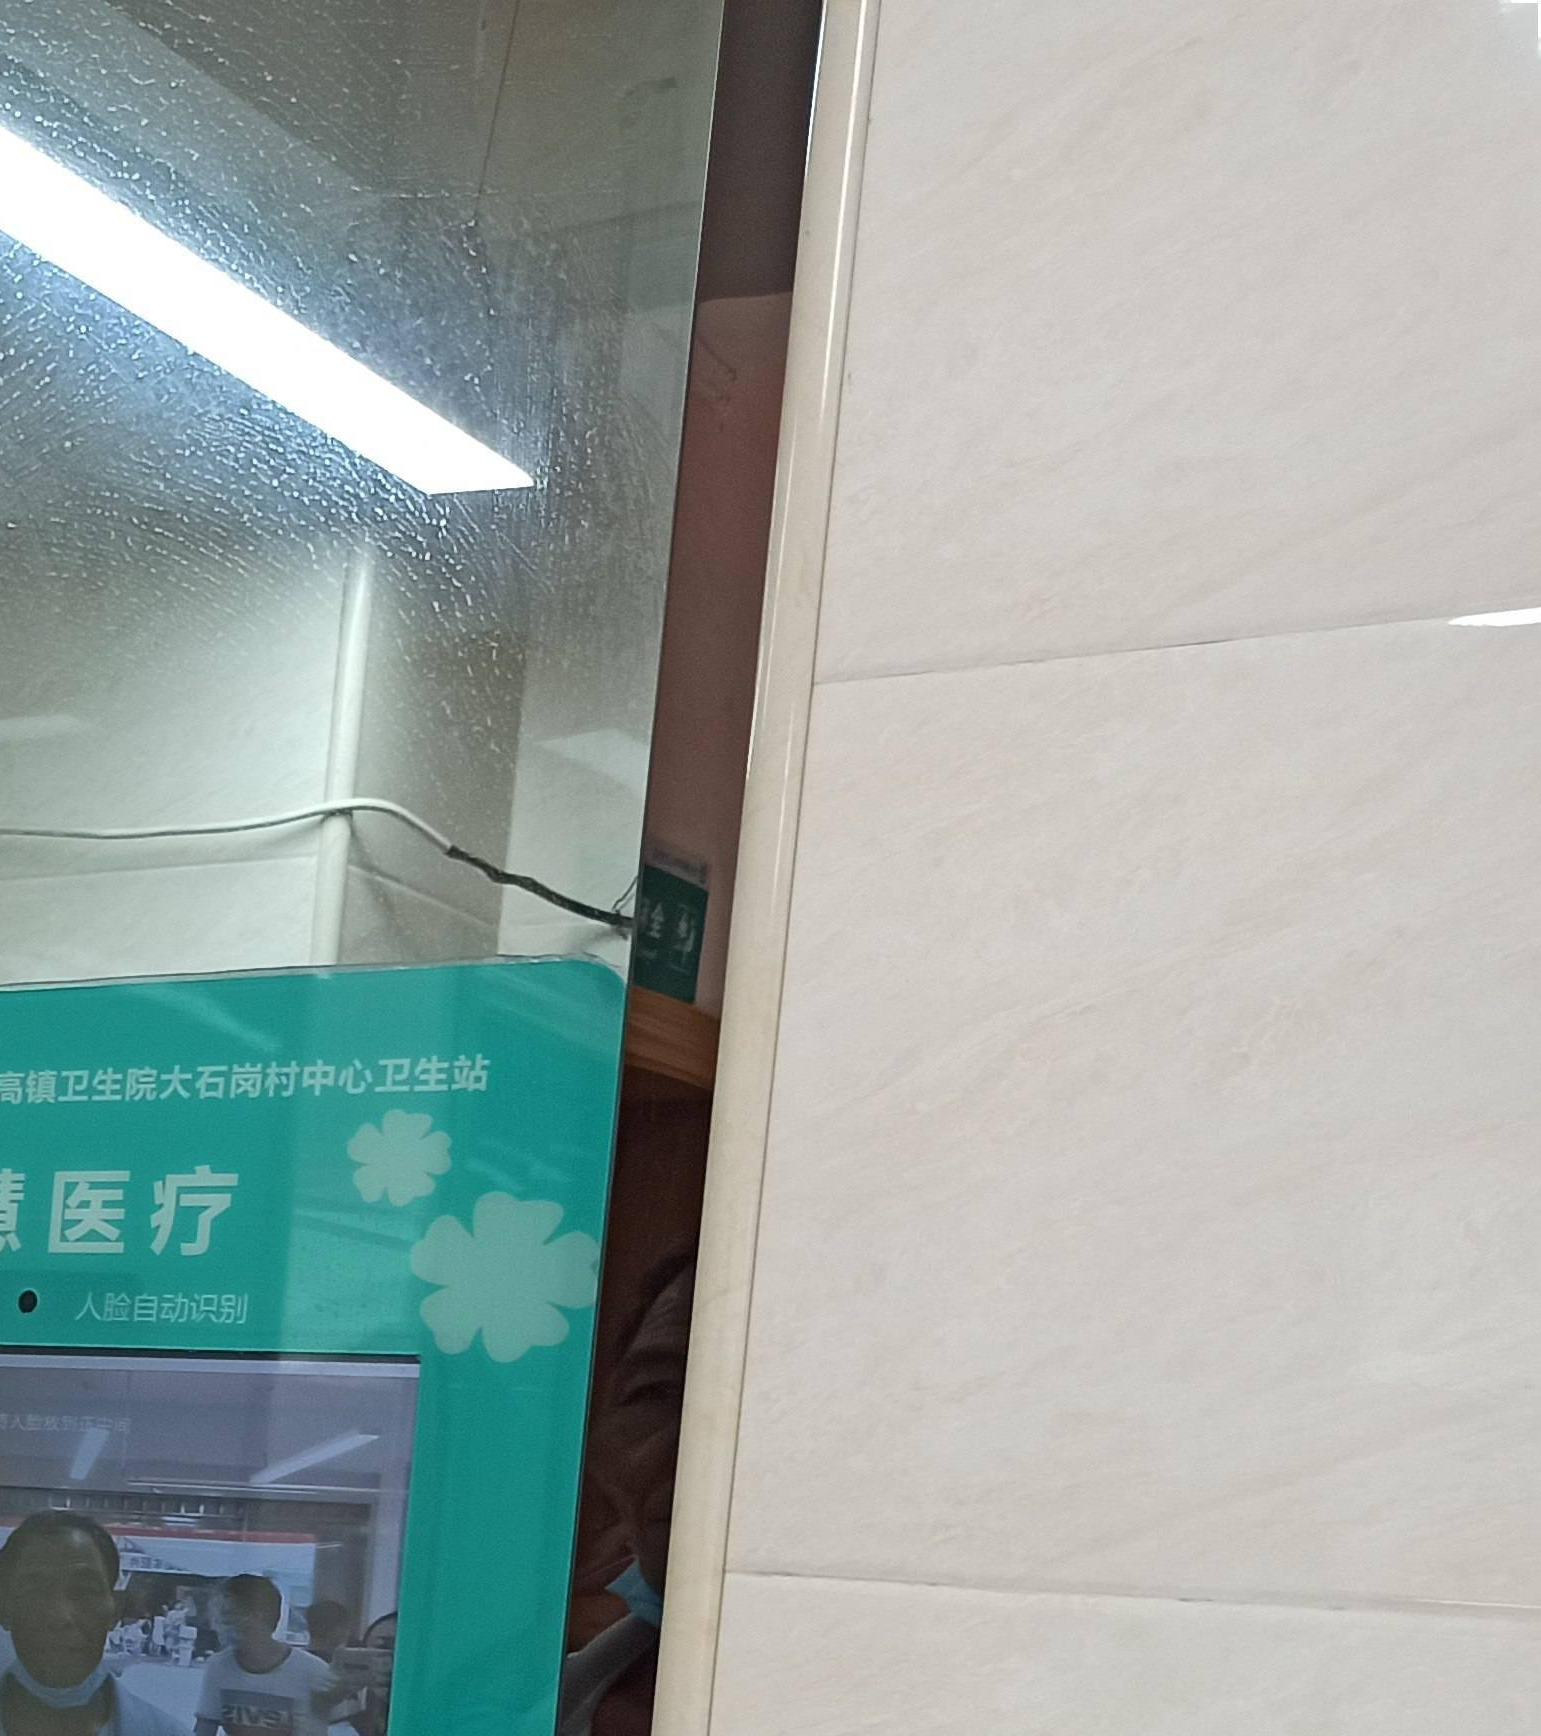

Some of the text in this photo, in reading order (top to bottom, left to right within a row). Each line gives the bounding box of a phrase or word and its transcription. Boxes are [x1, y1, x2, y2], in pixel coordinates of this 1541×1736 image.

[74, 1293, 248, 1324] 人脸自动识别
